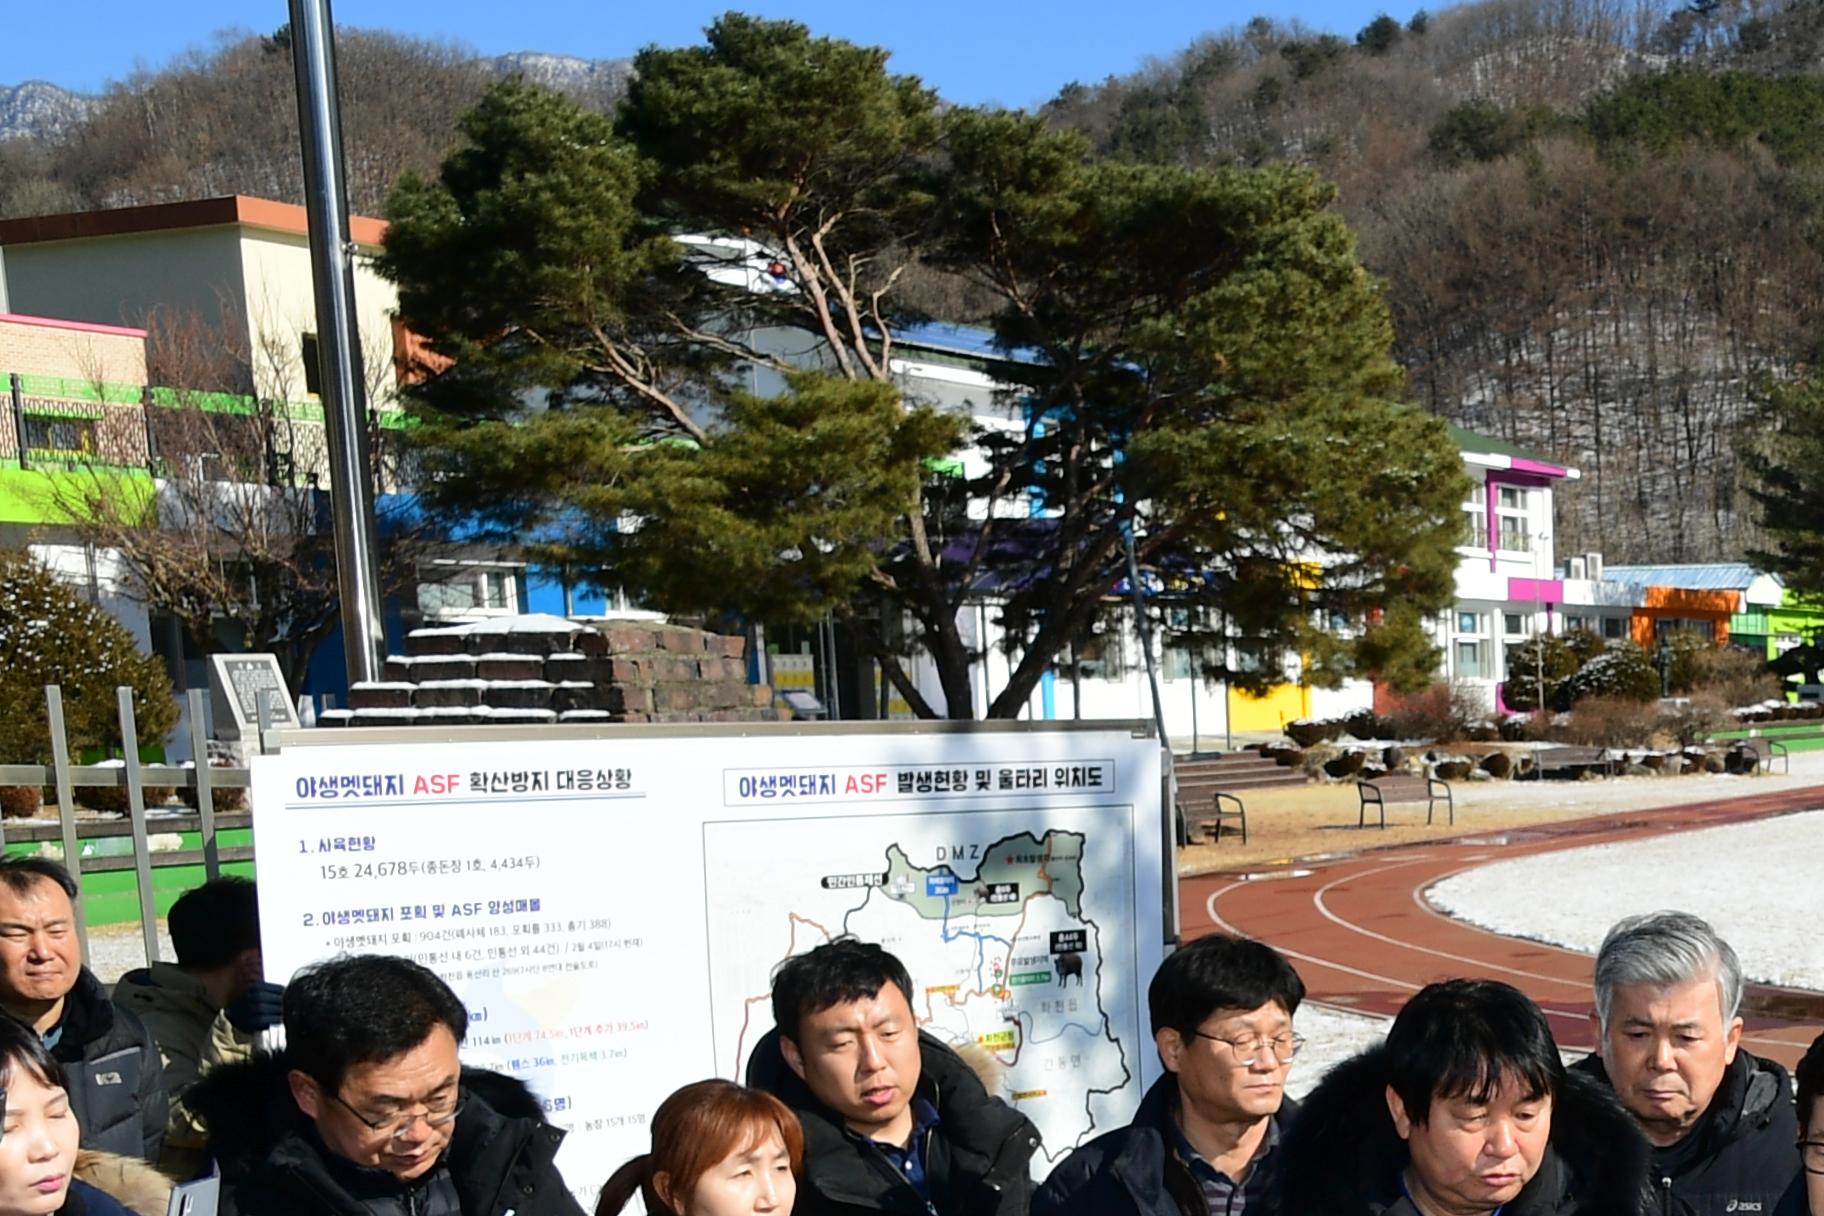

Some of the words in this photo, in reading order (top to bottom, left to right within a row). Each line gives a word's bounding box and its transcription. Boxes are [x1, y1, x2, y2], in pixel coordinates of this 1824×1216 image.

[296, 774, 404, 798] 야생멧돼지
[413, 774, 461, 794] ASF
[470, 771, 549, 793] 확산방지
[557, 768, 632, 790] 대응상황
[739, 773, 836, 799] 야생멧돼지
[845, 773, 888, 793] ASF
[897, 770, 969, 794] 발생현황
[976, 770, 991, 791] 및
[998, 768, 1048, 790] 울타리
[1054, 766, 1104, 788] 위치도
[322, 907, 394, 925] 야생멧돼지
[432, 904, 445, 918] 및
[452, 903, 482, 916] ASF
